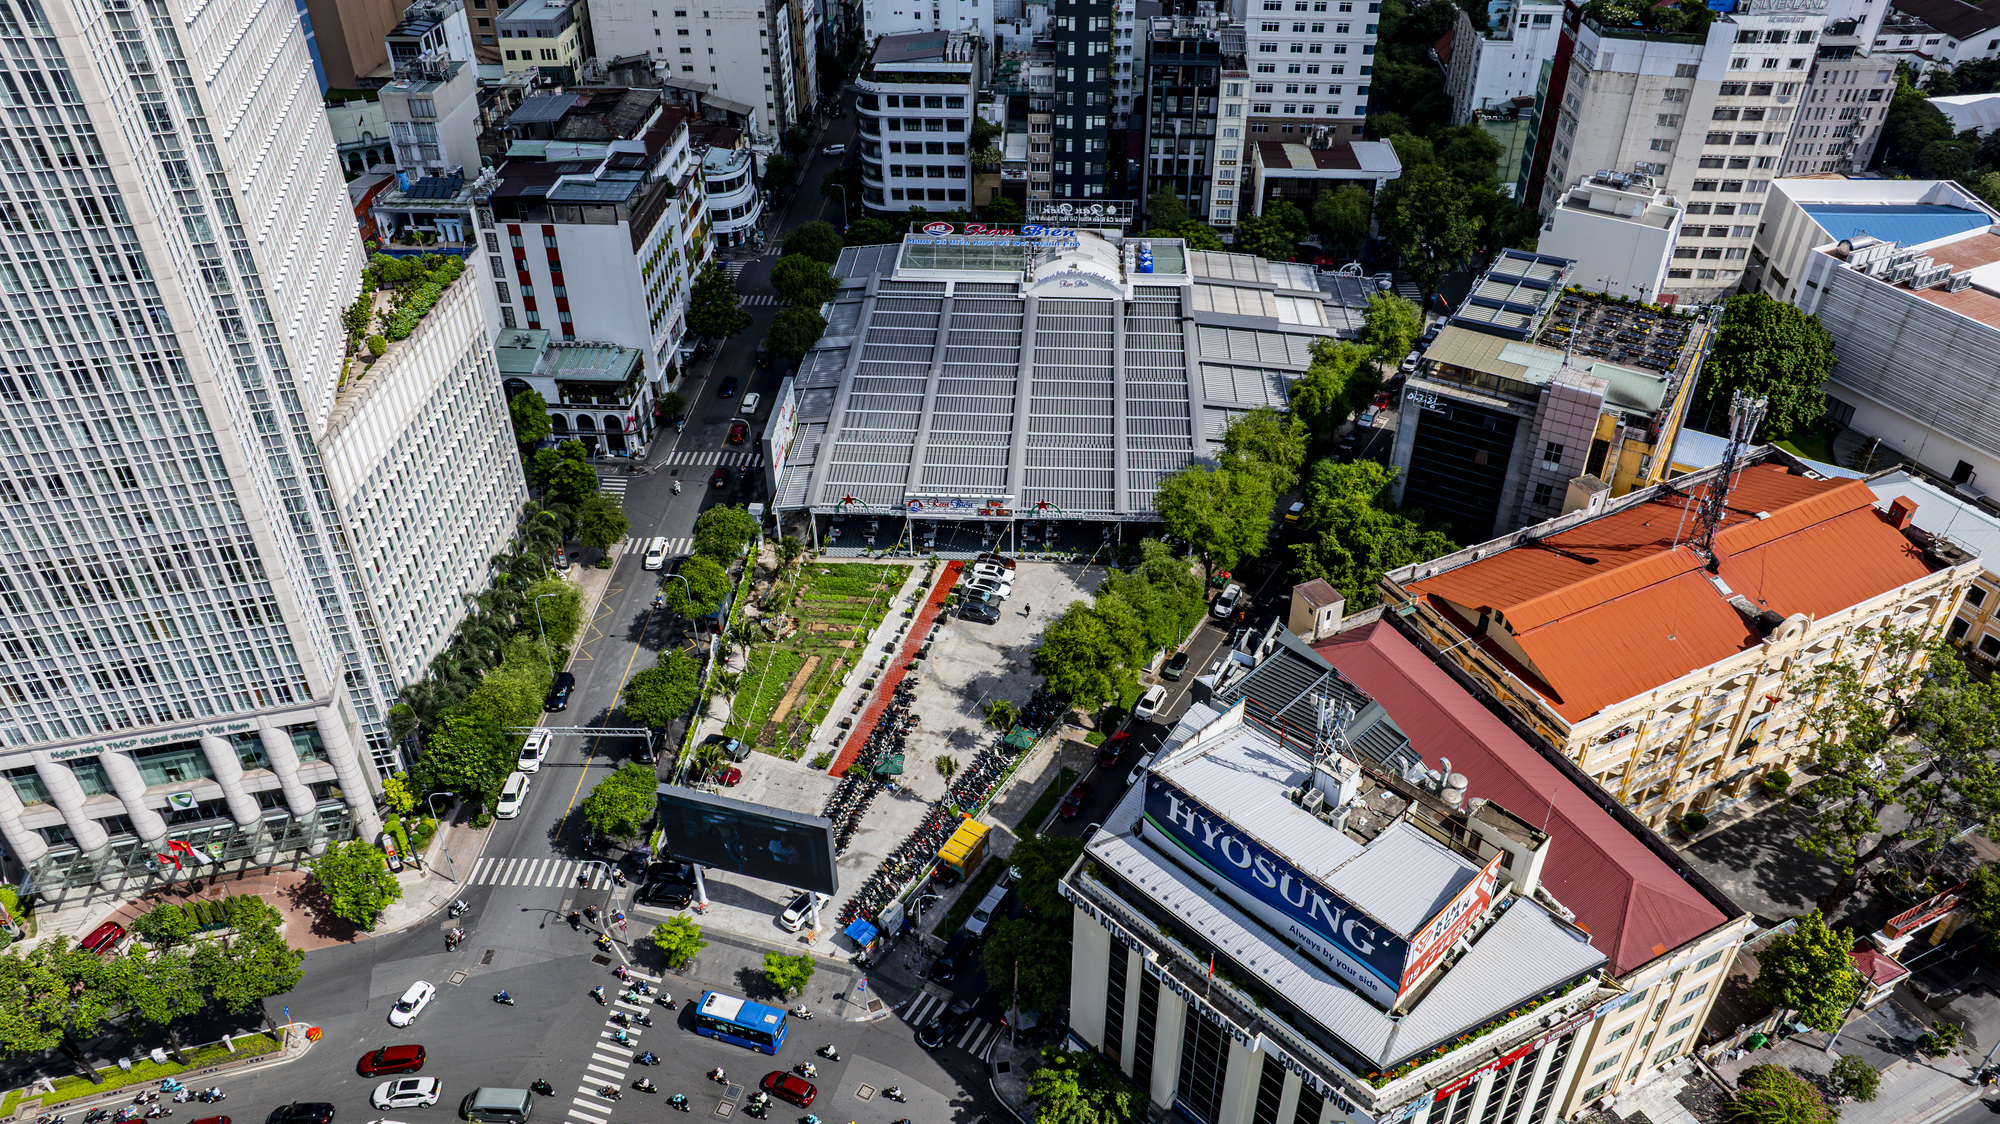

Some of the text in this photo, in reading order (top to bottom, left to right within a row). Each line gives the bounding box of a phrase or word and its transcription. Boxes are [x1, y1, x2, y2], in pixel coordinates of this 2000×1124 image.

[847, 504, 891, 514] Heineken
[1040, 509, 1085, 519] Heineken
[106, 739, 137, 751] TMCP
[227, 722, 250, 732] Nam
[1166, 792, 1376, 955] HYOSUNG
[1064, 886, 1144, 957] COCOA KITCHEN
[1436, 901, 1460, 931] KIM
[1289, 925, 1379, 992] Always by your side
[1405, 965, 1420, 987] 09
[1161, 972, 1197, 1010] COCOA
[1199, 1001, 1250, 1048] PROJECT
[1277, 1051, 1356, 1116] COCOA SHOP
